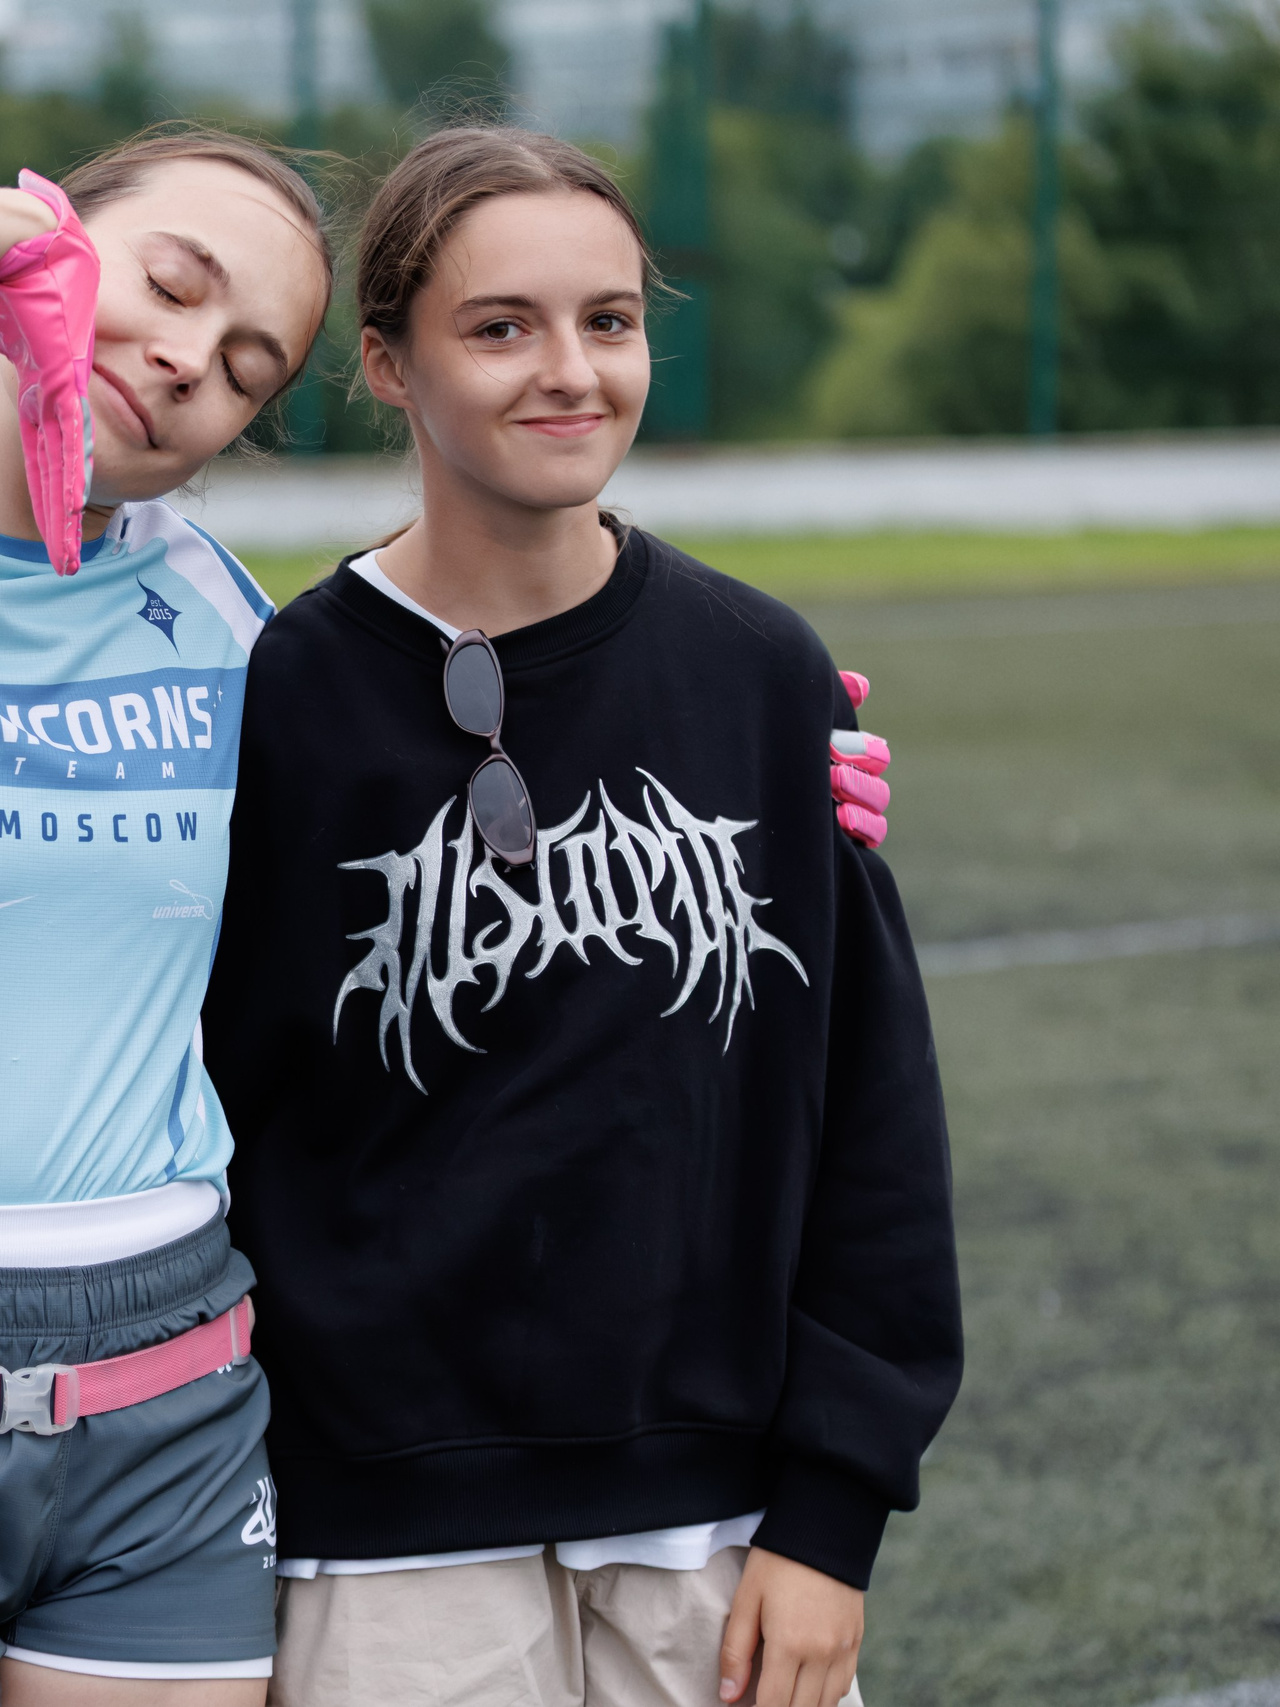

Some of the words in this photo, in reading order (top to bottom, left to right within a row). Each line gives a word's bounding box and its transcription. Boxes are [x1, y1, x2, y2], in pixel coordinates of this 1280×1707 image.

[150, 599, 163, 607] est.
[147, 608, 173, 621] 2015
[14, 757, 176, 779] TEAM
[152, 901, 211, 920] universe
